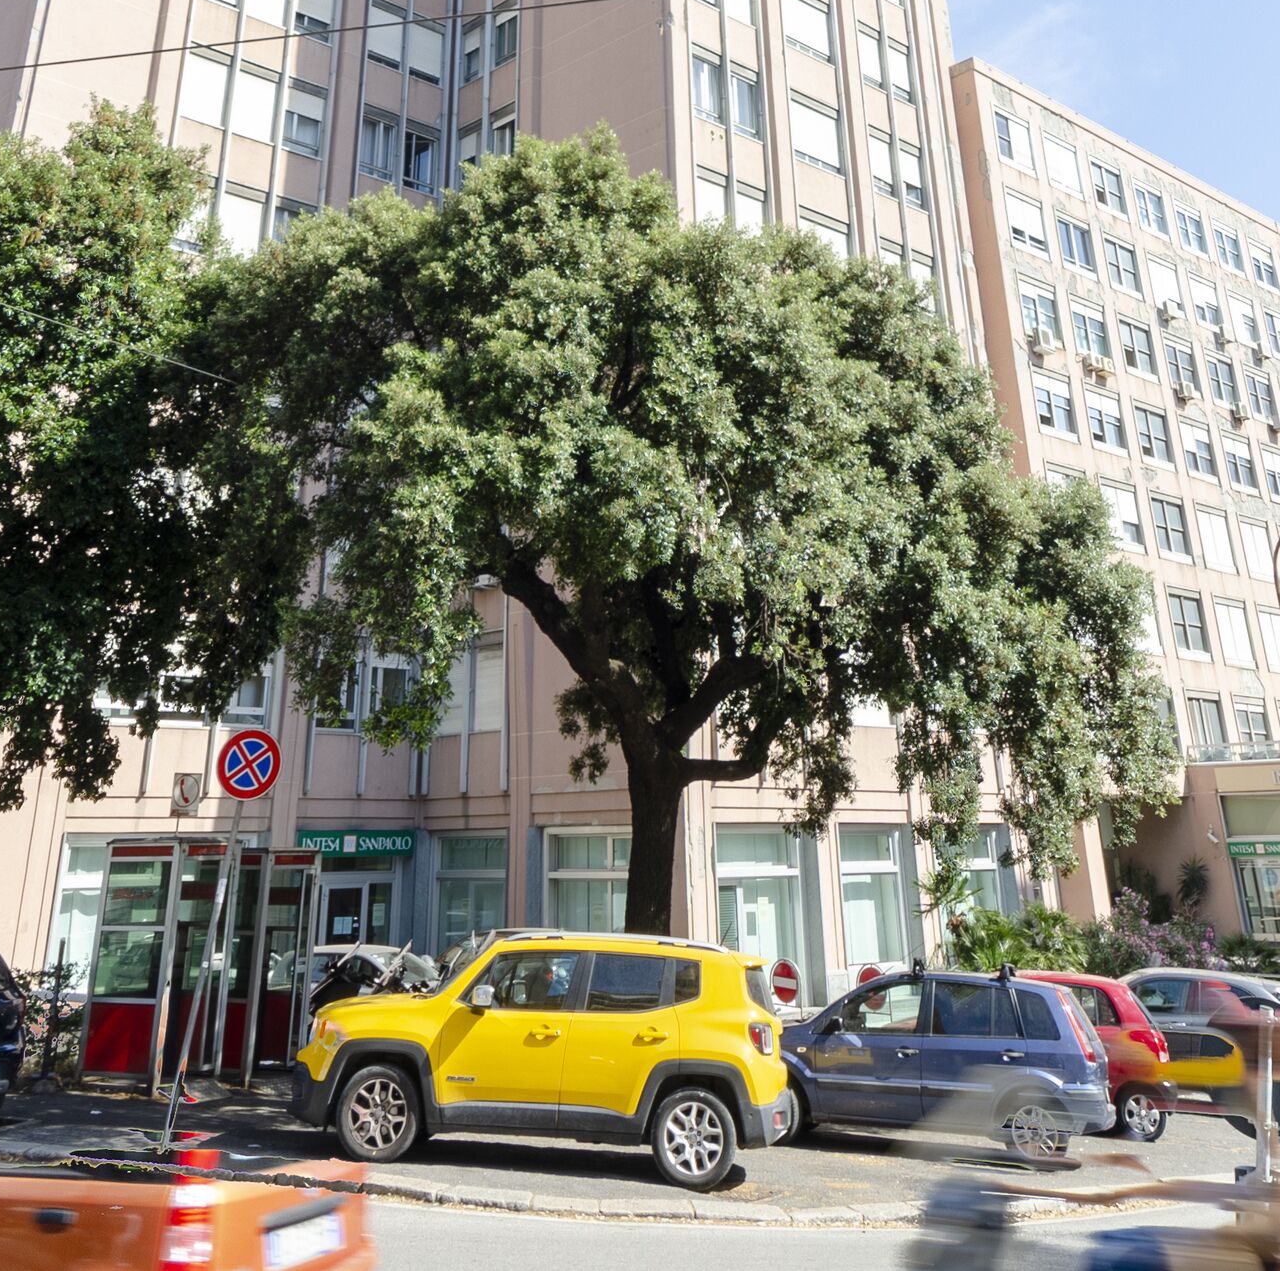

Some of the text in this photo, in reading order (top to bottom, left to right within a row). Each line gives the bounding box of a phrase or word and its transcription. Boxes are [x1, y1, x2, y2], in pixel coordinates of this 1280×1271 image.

[302, 836, 412, 852] INTESA SANPAOLO
[1230, 844, 1255, 854] INTESA
